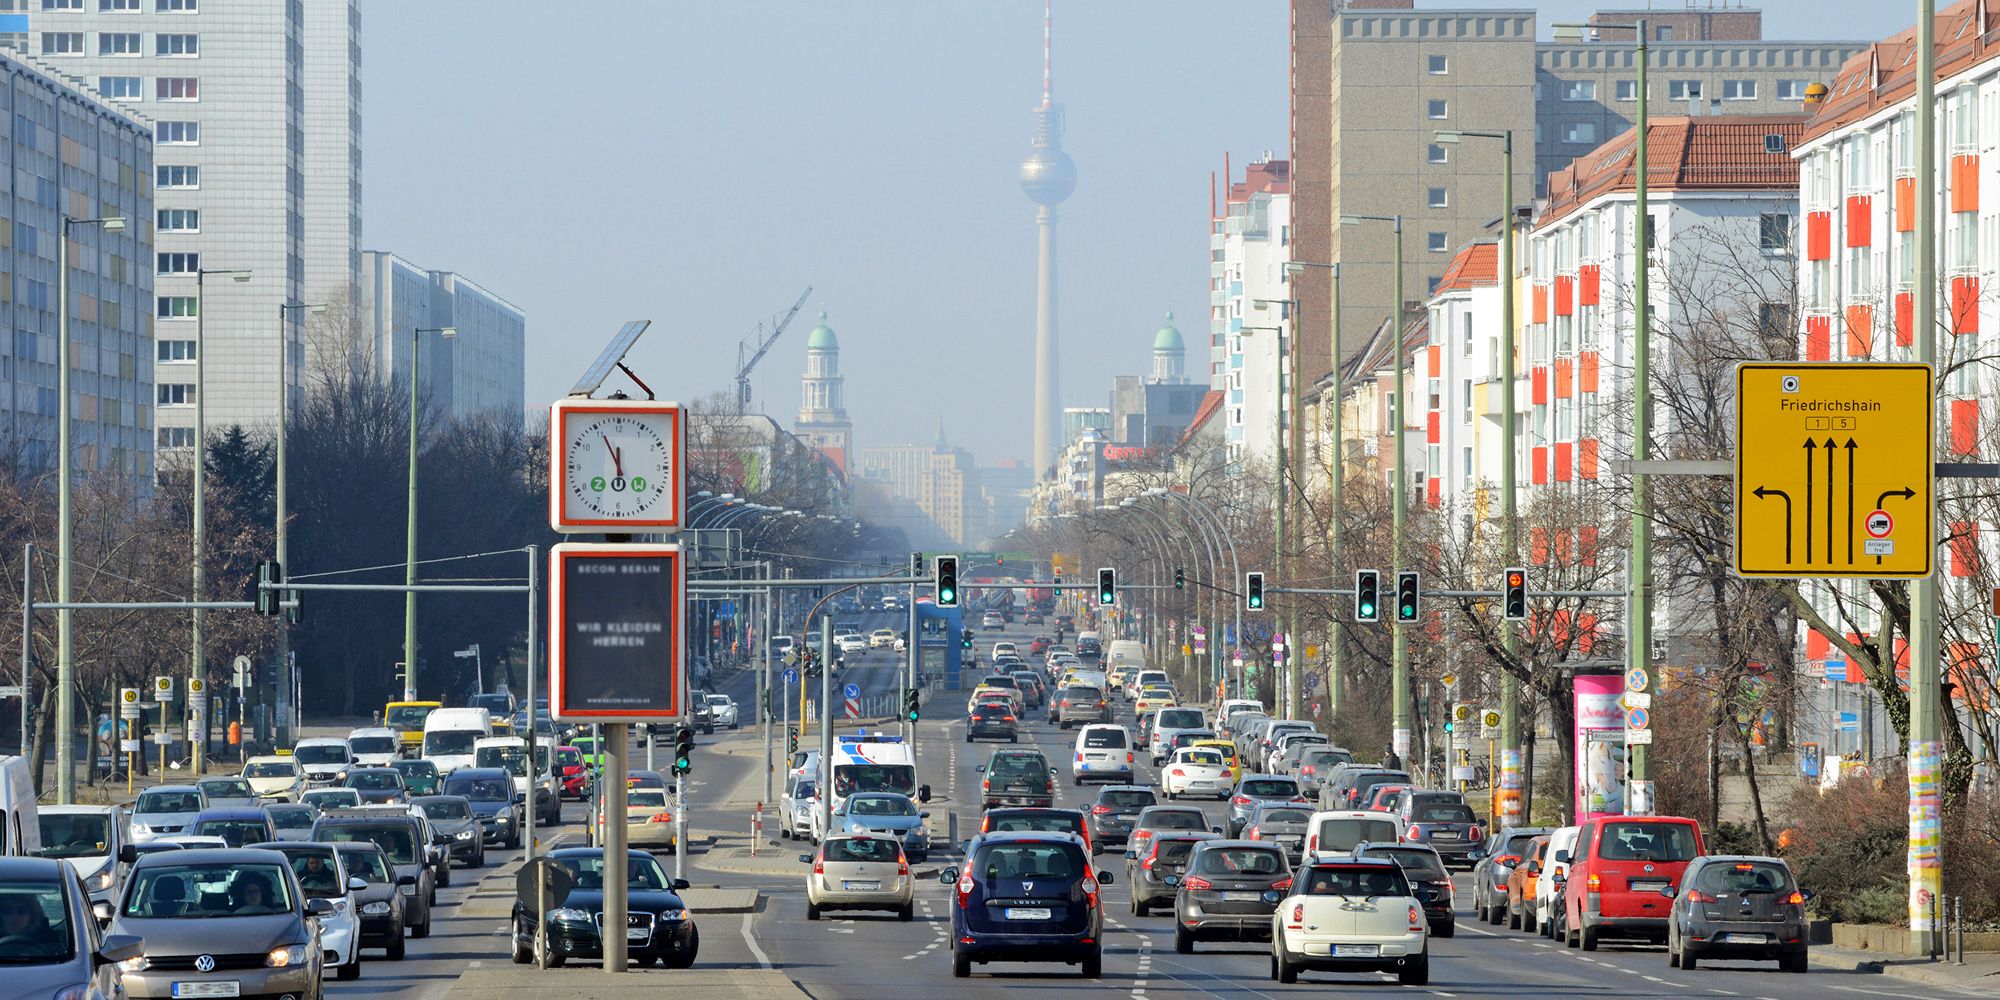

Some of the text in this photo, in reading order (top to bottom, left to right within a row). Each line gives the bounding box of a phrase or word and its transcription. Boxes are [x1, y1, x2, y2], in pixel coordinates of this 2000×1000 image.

[1781, 399, 1881, 411] Friedrichshain
[1816, 419, 1847, 428] 1 5
[578, 565, 660, 574] BECON BERLIN
[577, 622, 661, 632] WIR KLEIDEN
[593, 636, 645, 646] HERREN
